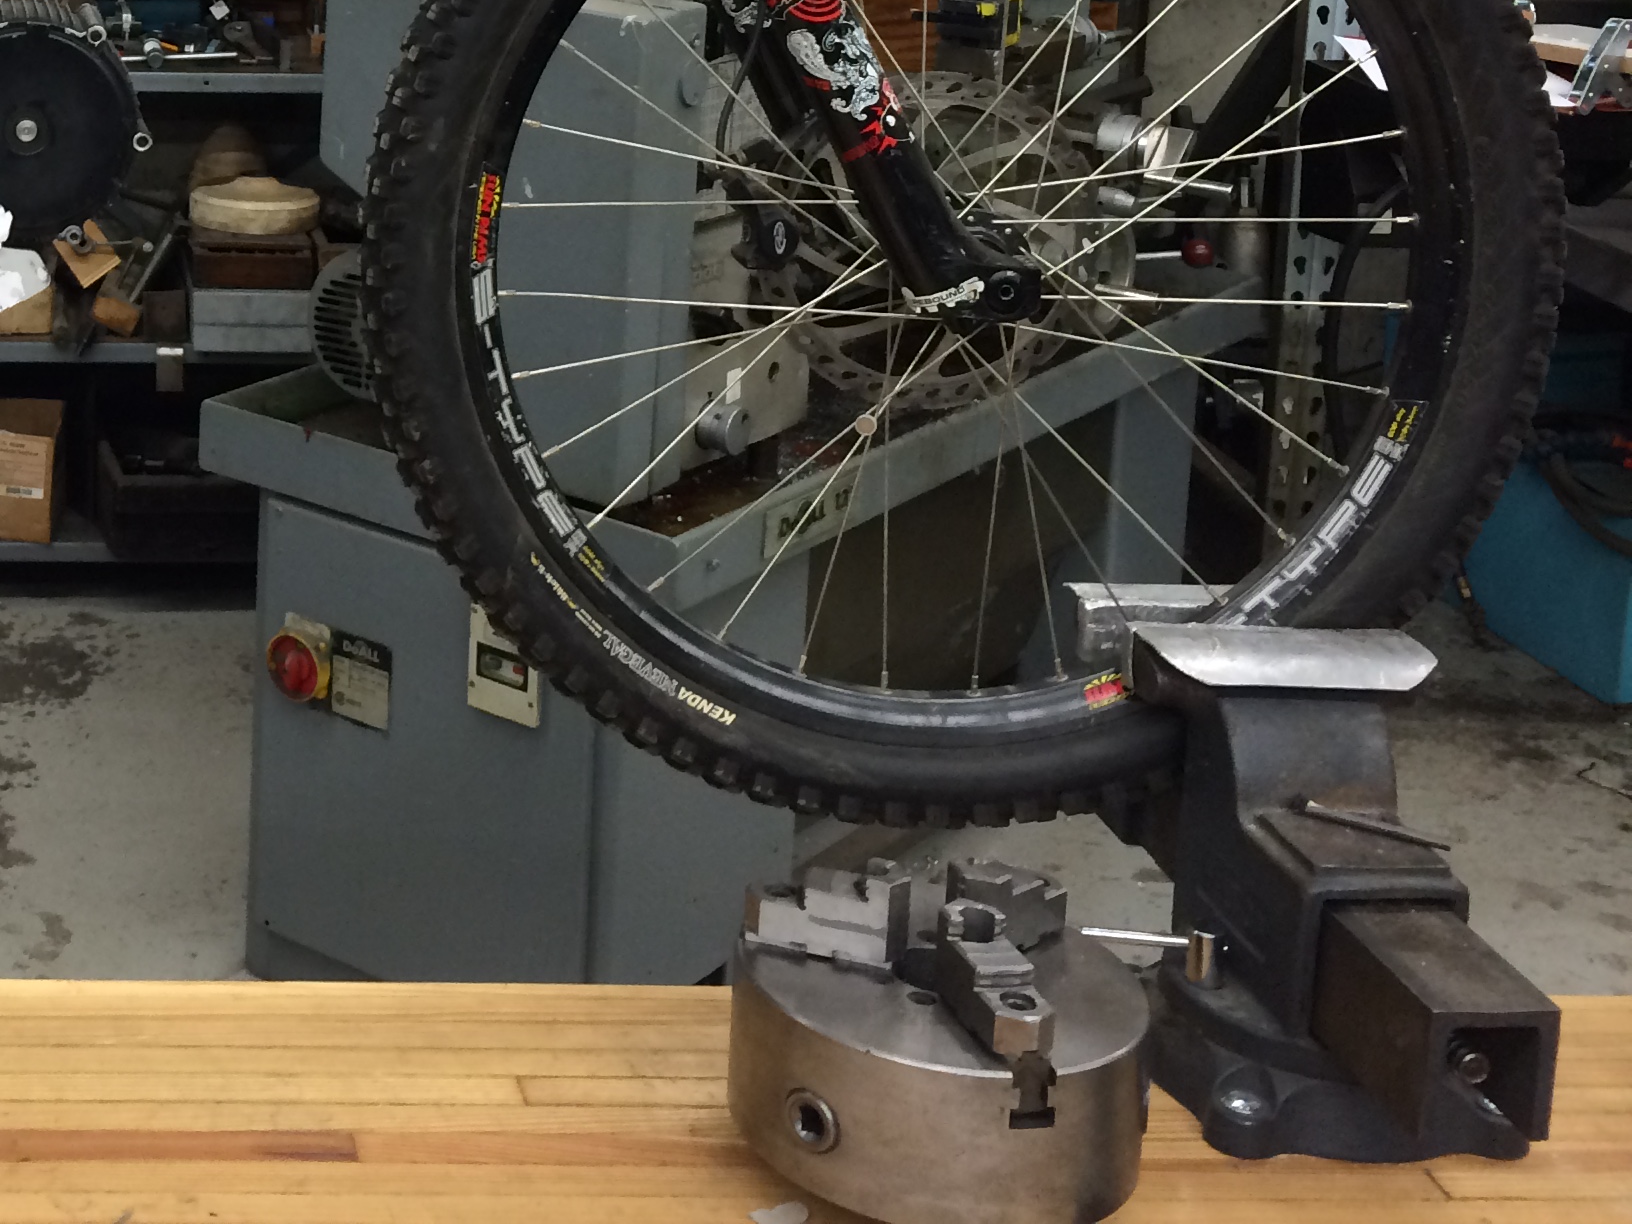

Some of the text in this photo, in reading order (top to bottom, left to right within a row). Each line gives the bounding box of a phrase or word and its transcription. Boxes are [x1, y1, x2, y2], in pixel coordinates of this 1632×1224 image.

[342, 639, 380, 663] DoALL
[602, 629, 679, 697] NEVEGAL
[677, 686, 737, 726] KENDA
